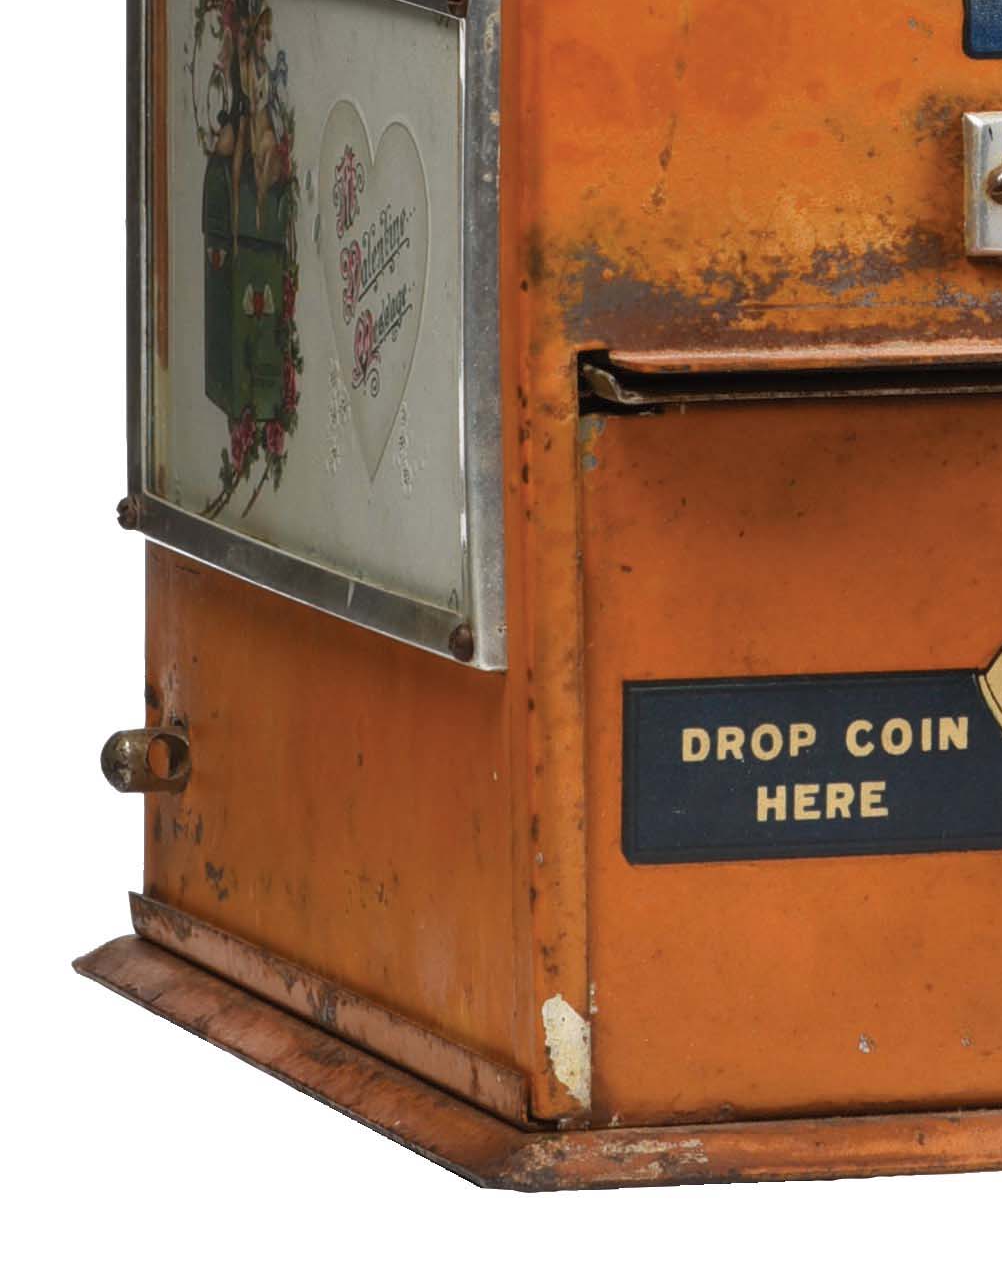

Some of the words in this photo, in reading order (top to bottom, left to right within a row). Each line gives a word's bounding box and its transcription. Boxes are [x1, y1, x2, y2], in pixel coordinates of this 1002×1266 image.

[681, 723, 817, 762] DROP
[845, 717, 970, 757] COIN
[756, 781, 890, 822] HERE
